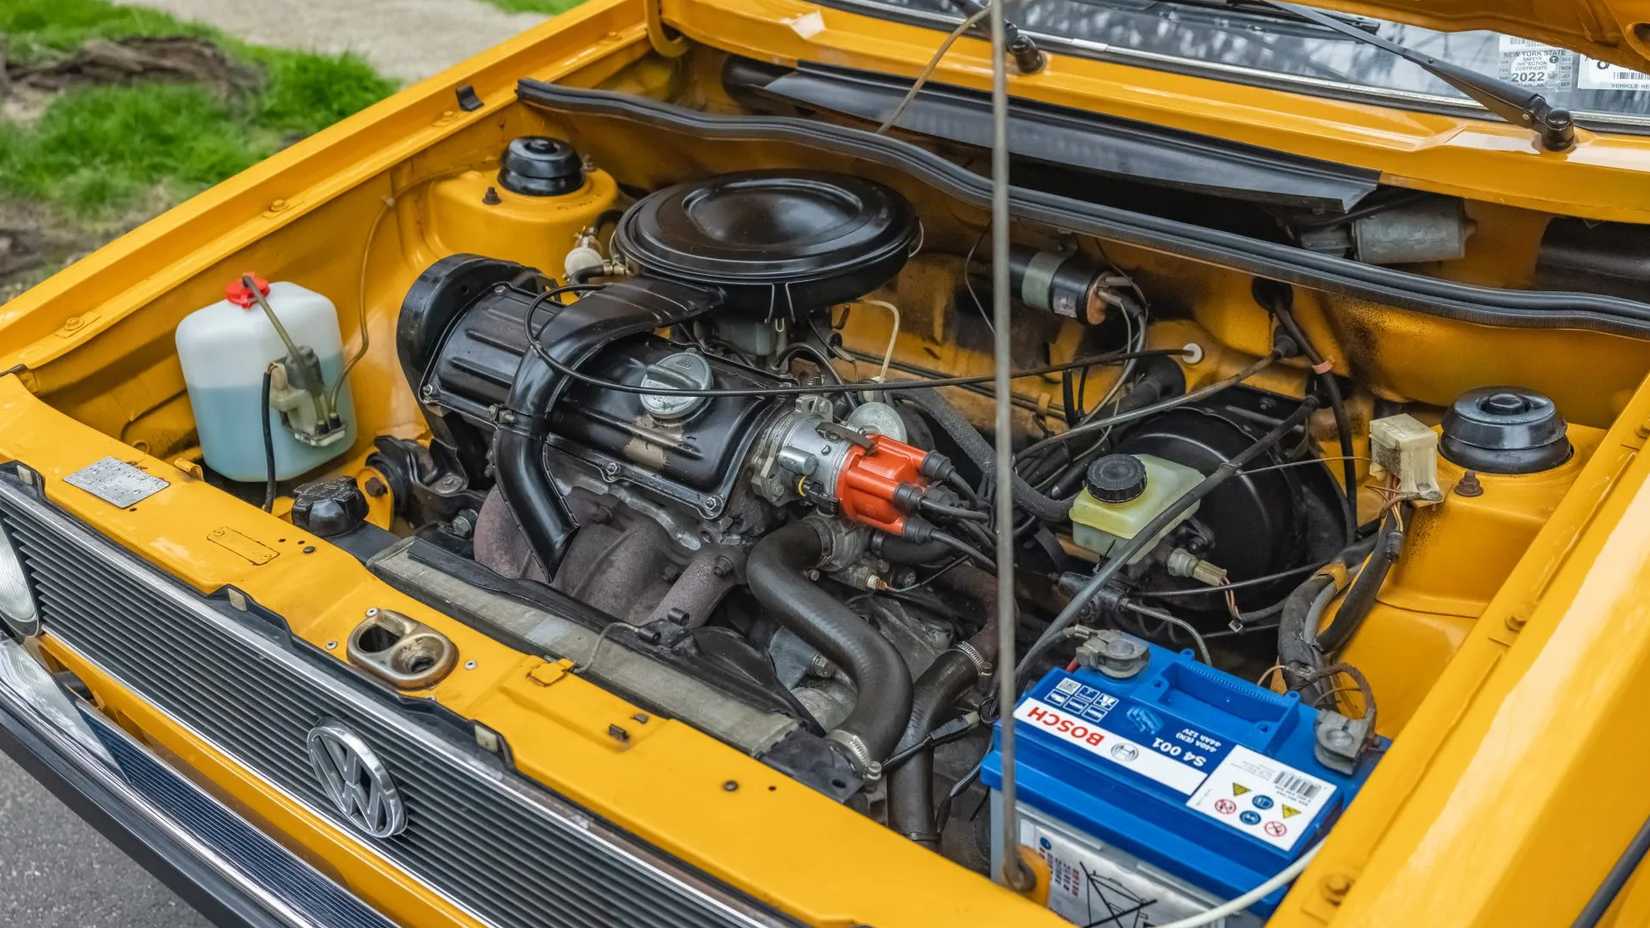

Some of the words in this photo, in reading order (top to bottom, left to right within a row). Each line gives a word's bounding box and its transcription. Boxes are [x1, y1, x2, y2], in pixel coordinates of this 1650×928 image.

[1511, 71, 1545, 82] 2022
[1027, 706, 1105, 747] BOSCH
[1182, 727, 1199, 738] 12V
[1152, 737, 1182, 757] 001
[1196, 740, 1218, 753] 440A
[1184, 751, 1207, 767] S4
